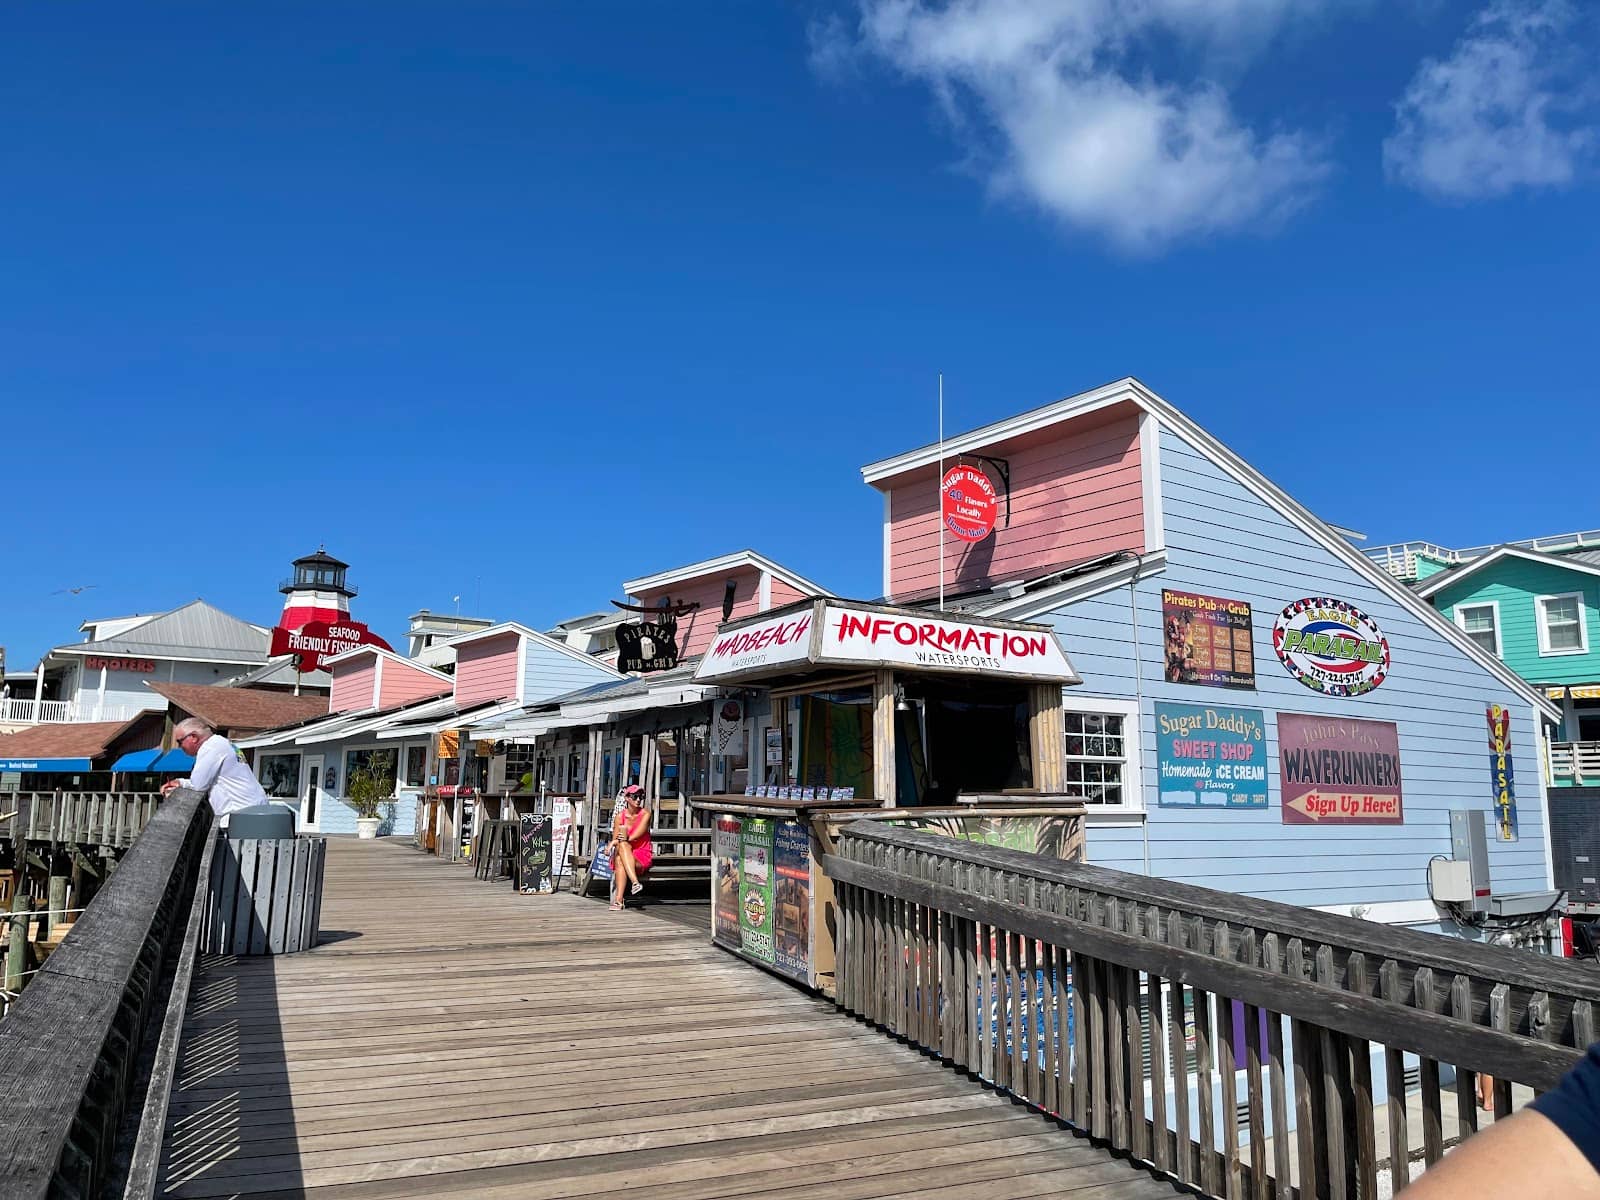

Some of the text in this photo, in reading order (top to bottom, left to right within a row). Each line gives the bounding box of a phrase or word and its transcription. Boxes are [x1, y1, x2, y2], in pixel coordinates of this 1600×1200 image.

[942, 472, 995, 504] Sugar Daddy's
[957, 504, 981, 519] Locally
[965, 496, 988, 508] Flavors
[1164, 592, 1196, 608] Pirates
[1198, 598, 1217, 610] Pub
[1228, 602, 1250, 616] Grub
[1305, 609, 1360, 629] EAGLE
[288, 635, 331, 652] FRIENDLY
[328, 626, 361, 641] SEAFOOD
[624, 625, 670, 643] PIRATES
[712, 615, 812, 658] MADBEACH
[832, 613, 1047, 658] INFORMATION
[1282, 629, 1385, 665] PARASAIL
[85, 656, 156, 672] HOOTERS
[627, 658, 642, 669] PUB
[914, 651, 1001, 668] WATERSPORTS
[1160, 709, 1262, 741] Sugar Daddy's
[1303, 721, 1347, 746] John's
[1173, 739, 1253, 761] SWEET SHOP
[1161, 760, 1213, 778] Homemade
[1234, 765, 1265, 780] CREAM
[1283, 747, 1399, 787] WAVERUNNERS
[1492, 704, 1511, 840] PARASAIL
[1204, 780, 1236, 790] Flavors
[1305, 795, 1397, 816] Sign Up Here!
[748, 822, 767, 834] EAGLE
[743, 833, 770, 847] PARASAIL
